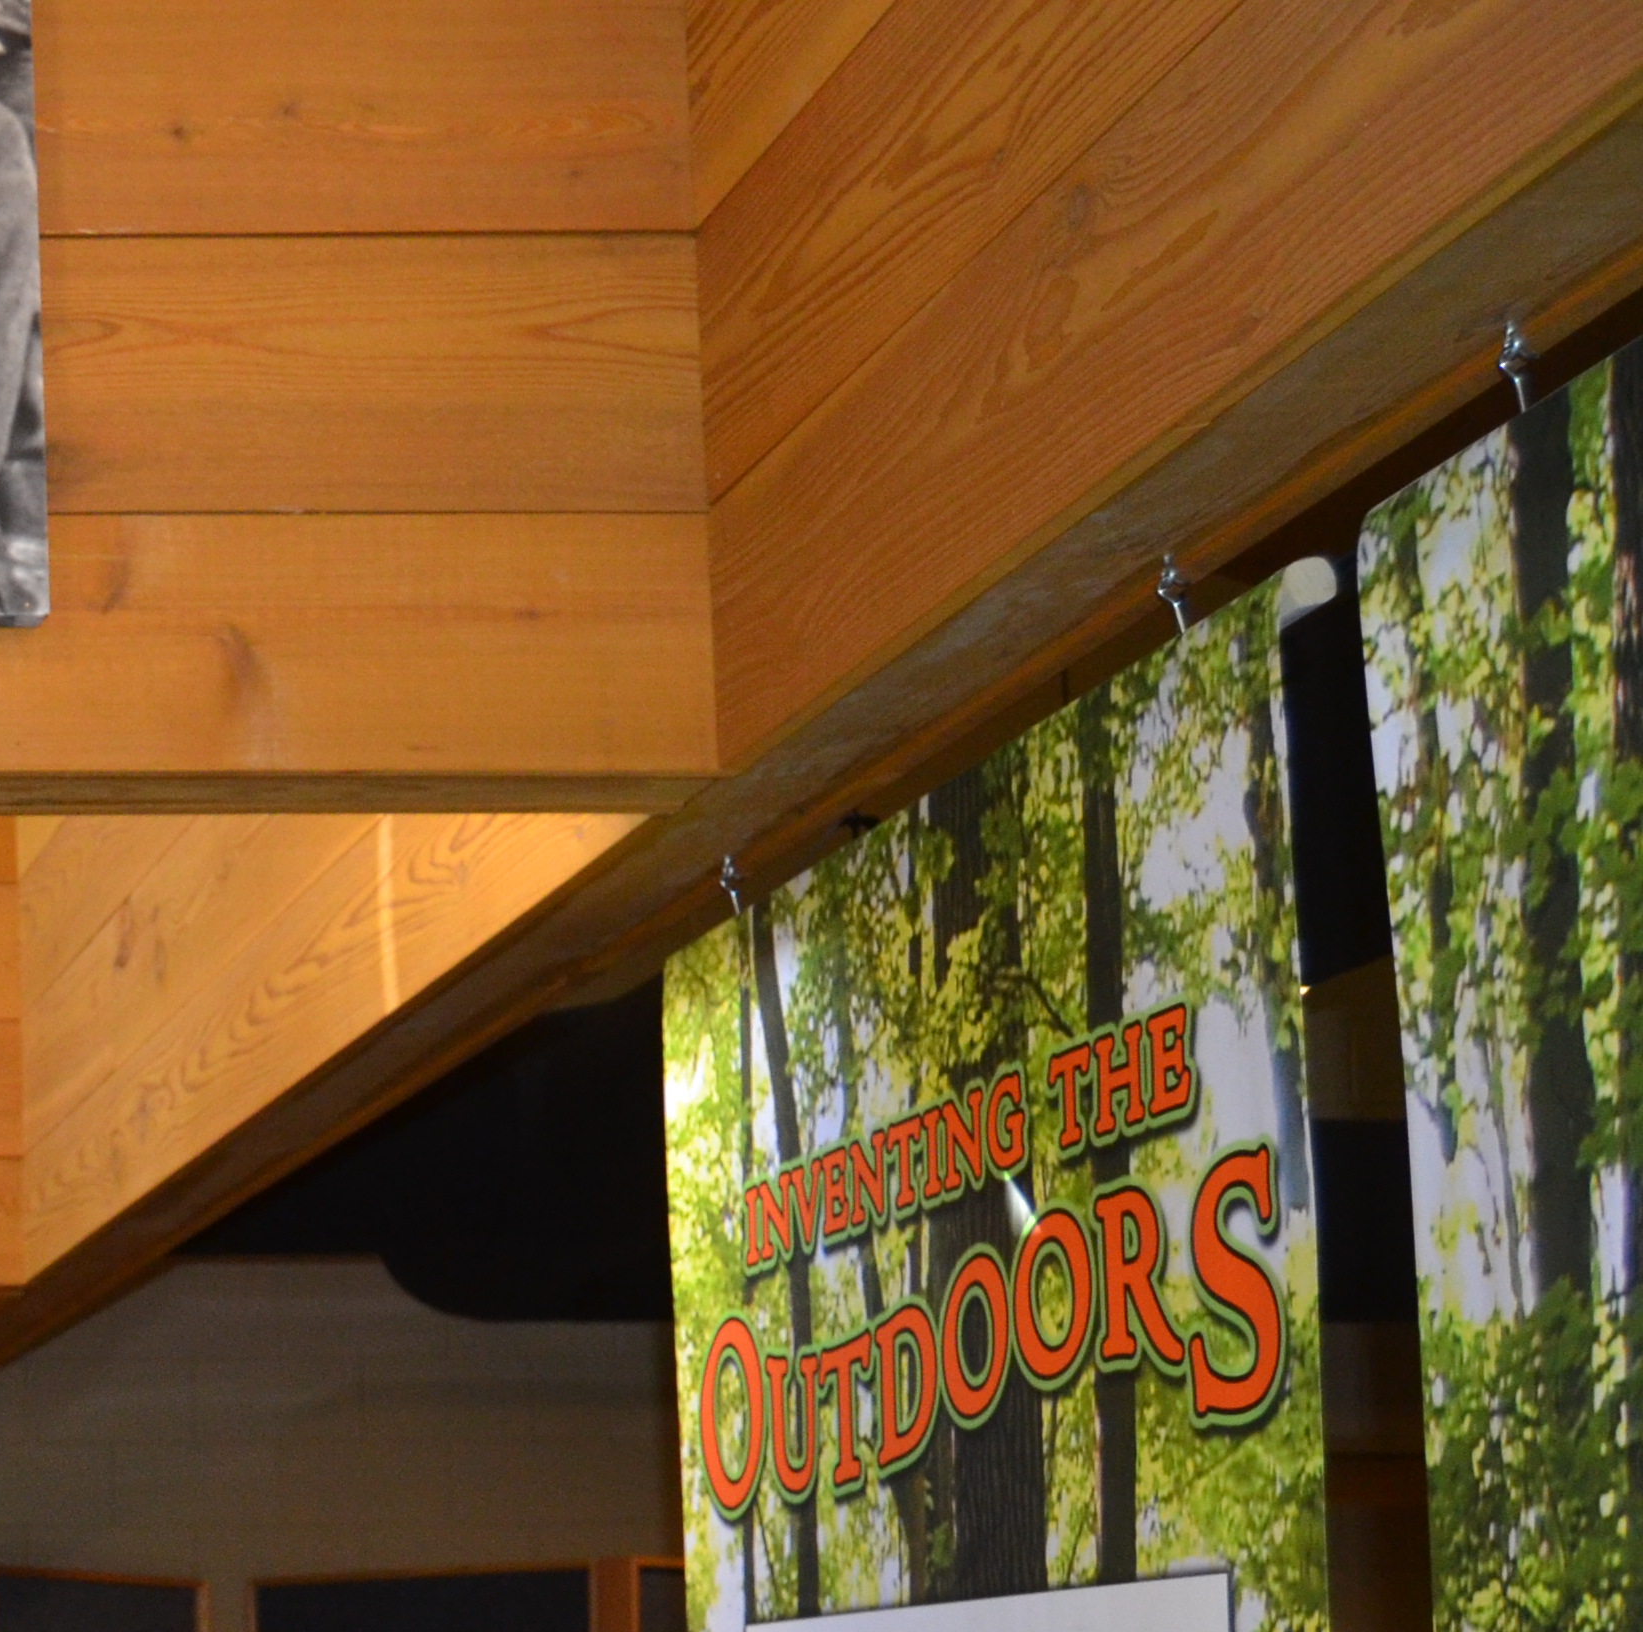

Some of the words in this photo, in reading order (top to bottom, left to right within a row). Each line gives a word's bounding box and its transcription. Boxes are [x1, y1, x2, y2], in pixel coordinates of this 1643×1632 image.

[743, 1067, 1029, 1272] INVENTING
[1047, 1002, 1193, 1150] THE
[701, 1146, 1286, 1512] OUTDOORS
